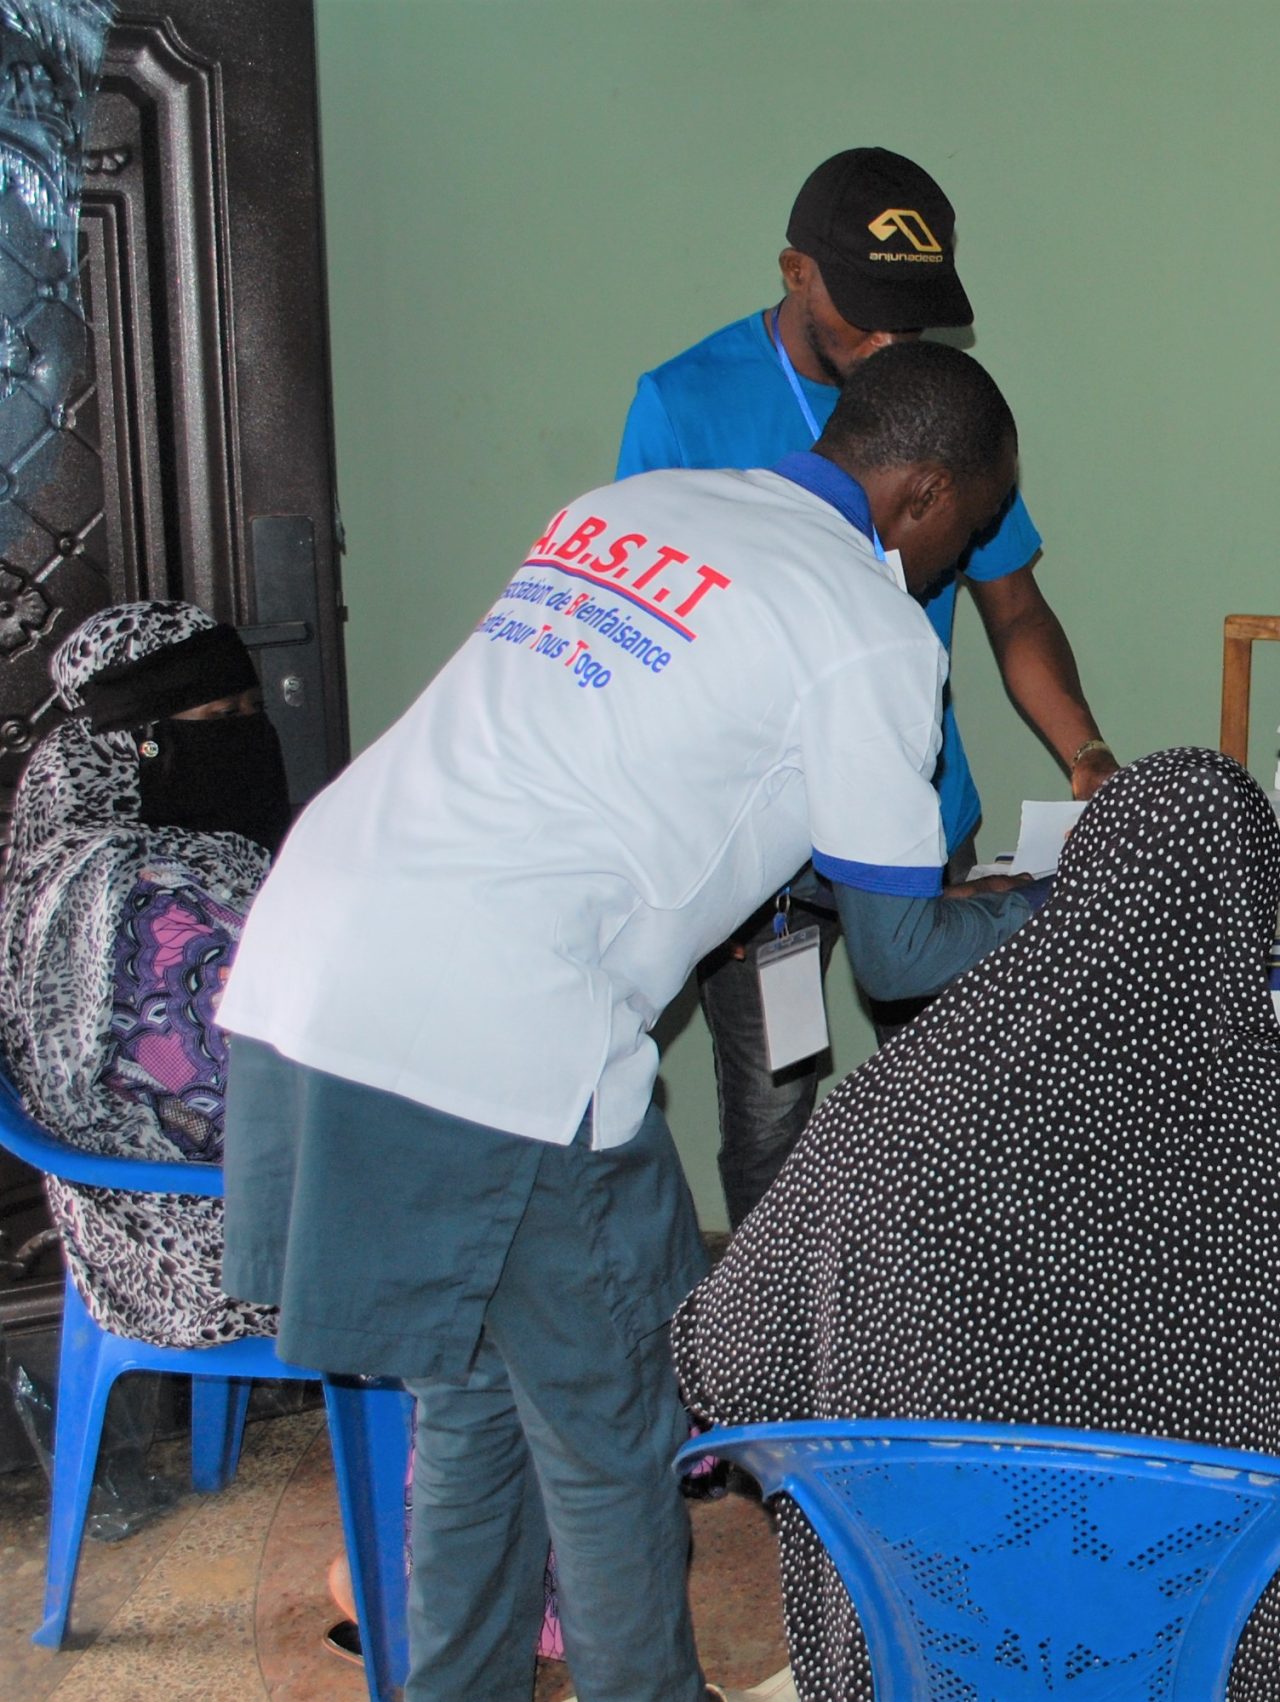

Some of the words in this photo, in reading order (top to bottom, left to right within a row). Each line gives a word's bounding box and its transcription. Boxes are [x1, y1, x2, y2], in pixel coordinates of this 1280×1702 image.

[490, 620, 537, 644] pour
[529, 624, 570, 659] Tous
[564, 640, 612, 689] Togo
[546, 588, 573, 611] de
[564, 592, 672, 674] Bienfaisance
